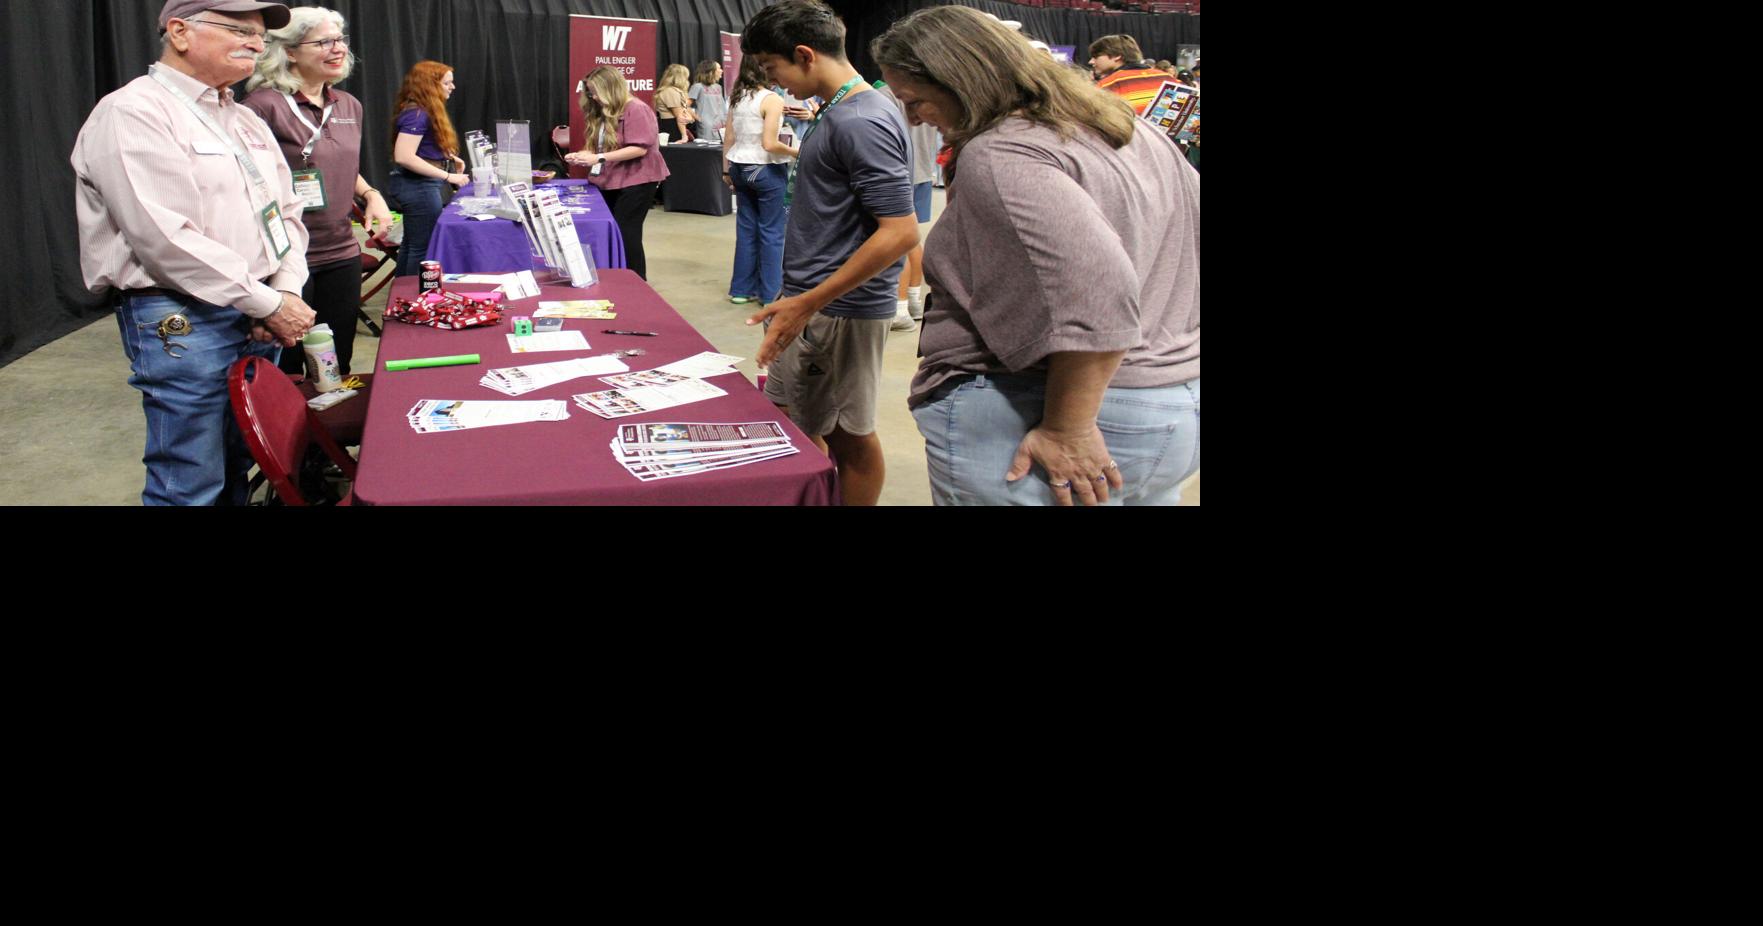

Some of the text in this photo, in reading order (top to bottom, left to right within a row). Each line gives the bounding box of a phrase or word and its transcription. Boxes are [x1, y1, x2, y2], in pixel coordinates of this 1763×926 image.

[602, 25, 632, 51] WT
[595, 56, 636, 65] PAUL ENGLER
[625, 66, 635, 75] OF
